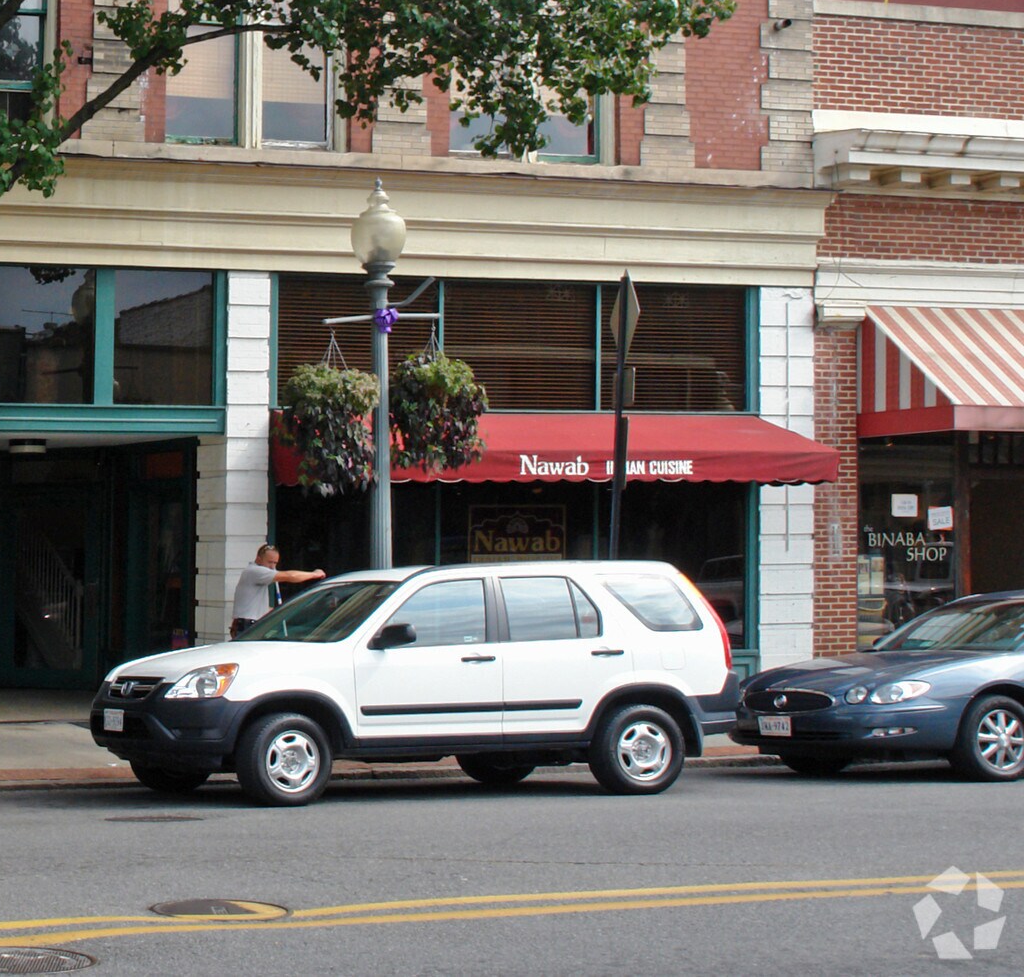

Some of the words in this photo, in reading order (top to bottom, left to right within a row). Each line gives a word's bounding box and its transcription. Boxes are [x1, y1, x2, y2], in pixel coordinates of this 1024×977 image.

[519, 454, 589, 476] Nawab
[649, 460, 694, 475] CUISINE
[474, 529, 561, 552] Nawab
[868, 532, 927, 548] BINABA
[906, 547, 947, 562] SHOP
